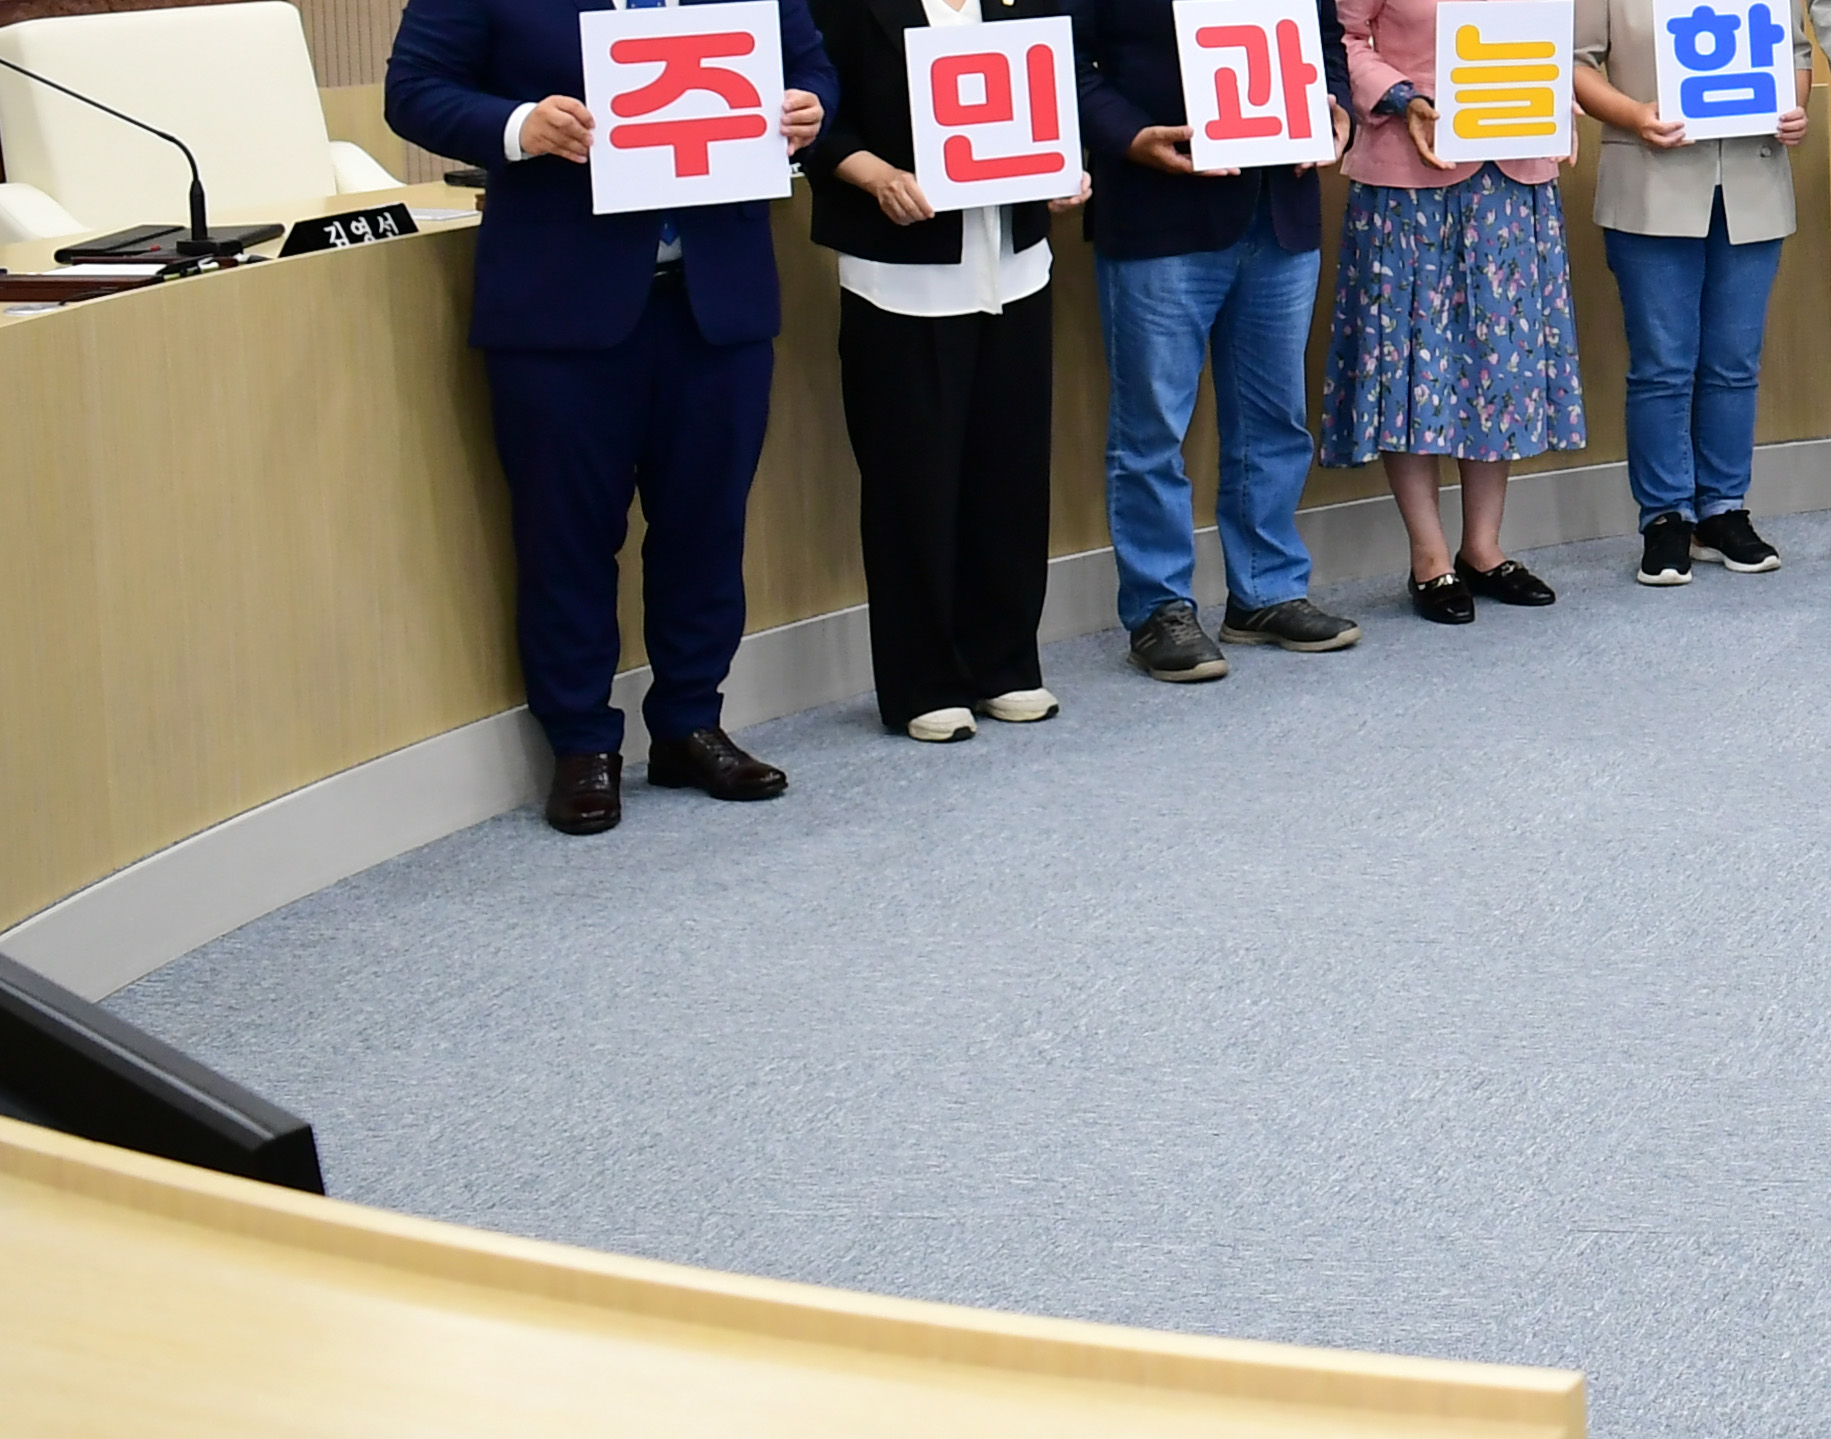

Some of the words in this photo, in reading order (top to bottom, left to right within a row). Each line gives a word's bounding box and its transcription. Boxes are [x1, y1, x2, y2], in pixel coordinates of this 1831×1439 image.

[609, 31, 768, 178] 주
[930, 43, 1066, 184] 민
[1195, 18, 1318, 141] 과
[1449, 23, 1561, 141] 늘
[1665, 1, 1786, 121] 함
